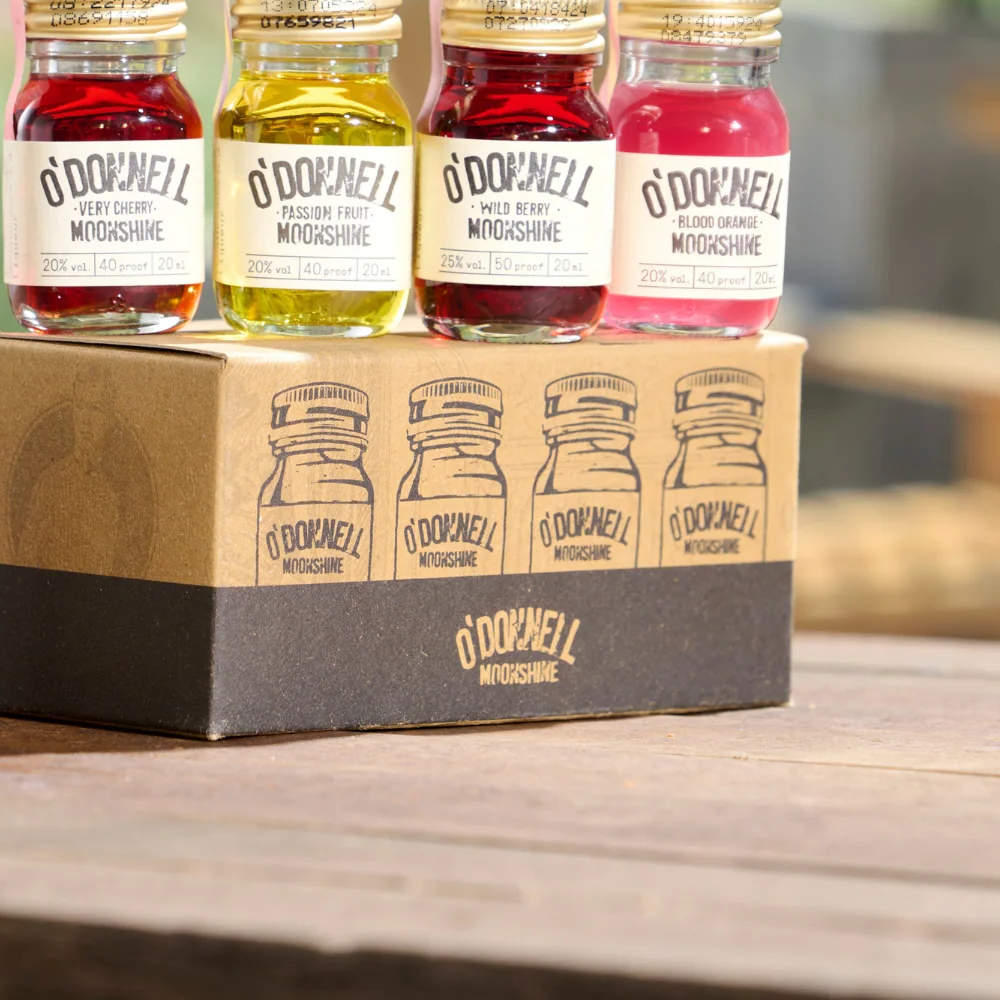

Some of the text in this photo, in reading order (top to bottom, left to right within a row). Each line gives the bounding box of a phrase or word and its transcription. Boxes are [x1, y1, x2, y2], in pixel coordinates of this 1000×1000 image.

[40, 151, 191, 207] O'DONNELL
[248, 156, 400, 212] O'DONNELL
[442, 151, 594, 208] O'DONNELL
[642, 166, 783, 220] O'DONNELL
[79, 201, 153, 216] VERY CHERRY
[282, 205, 369, 220] PASSION FRUIT
[481, 201, 551, 216] WILD BERRY
[70, 220, 165, 242] MOONSHINE
[277, 222, 372, 246] MOONSHINE
[468, 218, 563, 243] MOONSHINE
[678, 215, 759, 229] BLOOD ORANGE
[671, 232, 763, 257] MOONSHINE
[43, 258, 67, 272] 20%
[71, 262, 91, 272] vol.
[248, 260, 272, 274] 20%
[441, 255, 463, 269] 25%
[466, 259, 486, 270] vol.
[641, 268, 667, 283] 20%
[540, 506, 631, 548] O'DONNELL
[670, 500, 758, 541] O'DONNELL
[266, 518, 363, 560] O'DONNELL
[404, 512, 497, 554] O'DONNELL
[419, 551, 478, 568] MOONSHINE
[554, 544, 612, 561] MOONSHINE
[283, 557, 344, 574] MOONSHINE
[455, 607, 580, 670] O'DONNELL
[480, 660, 559, 686] MOONSHINE
